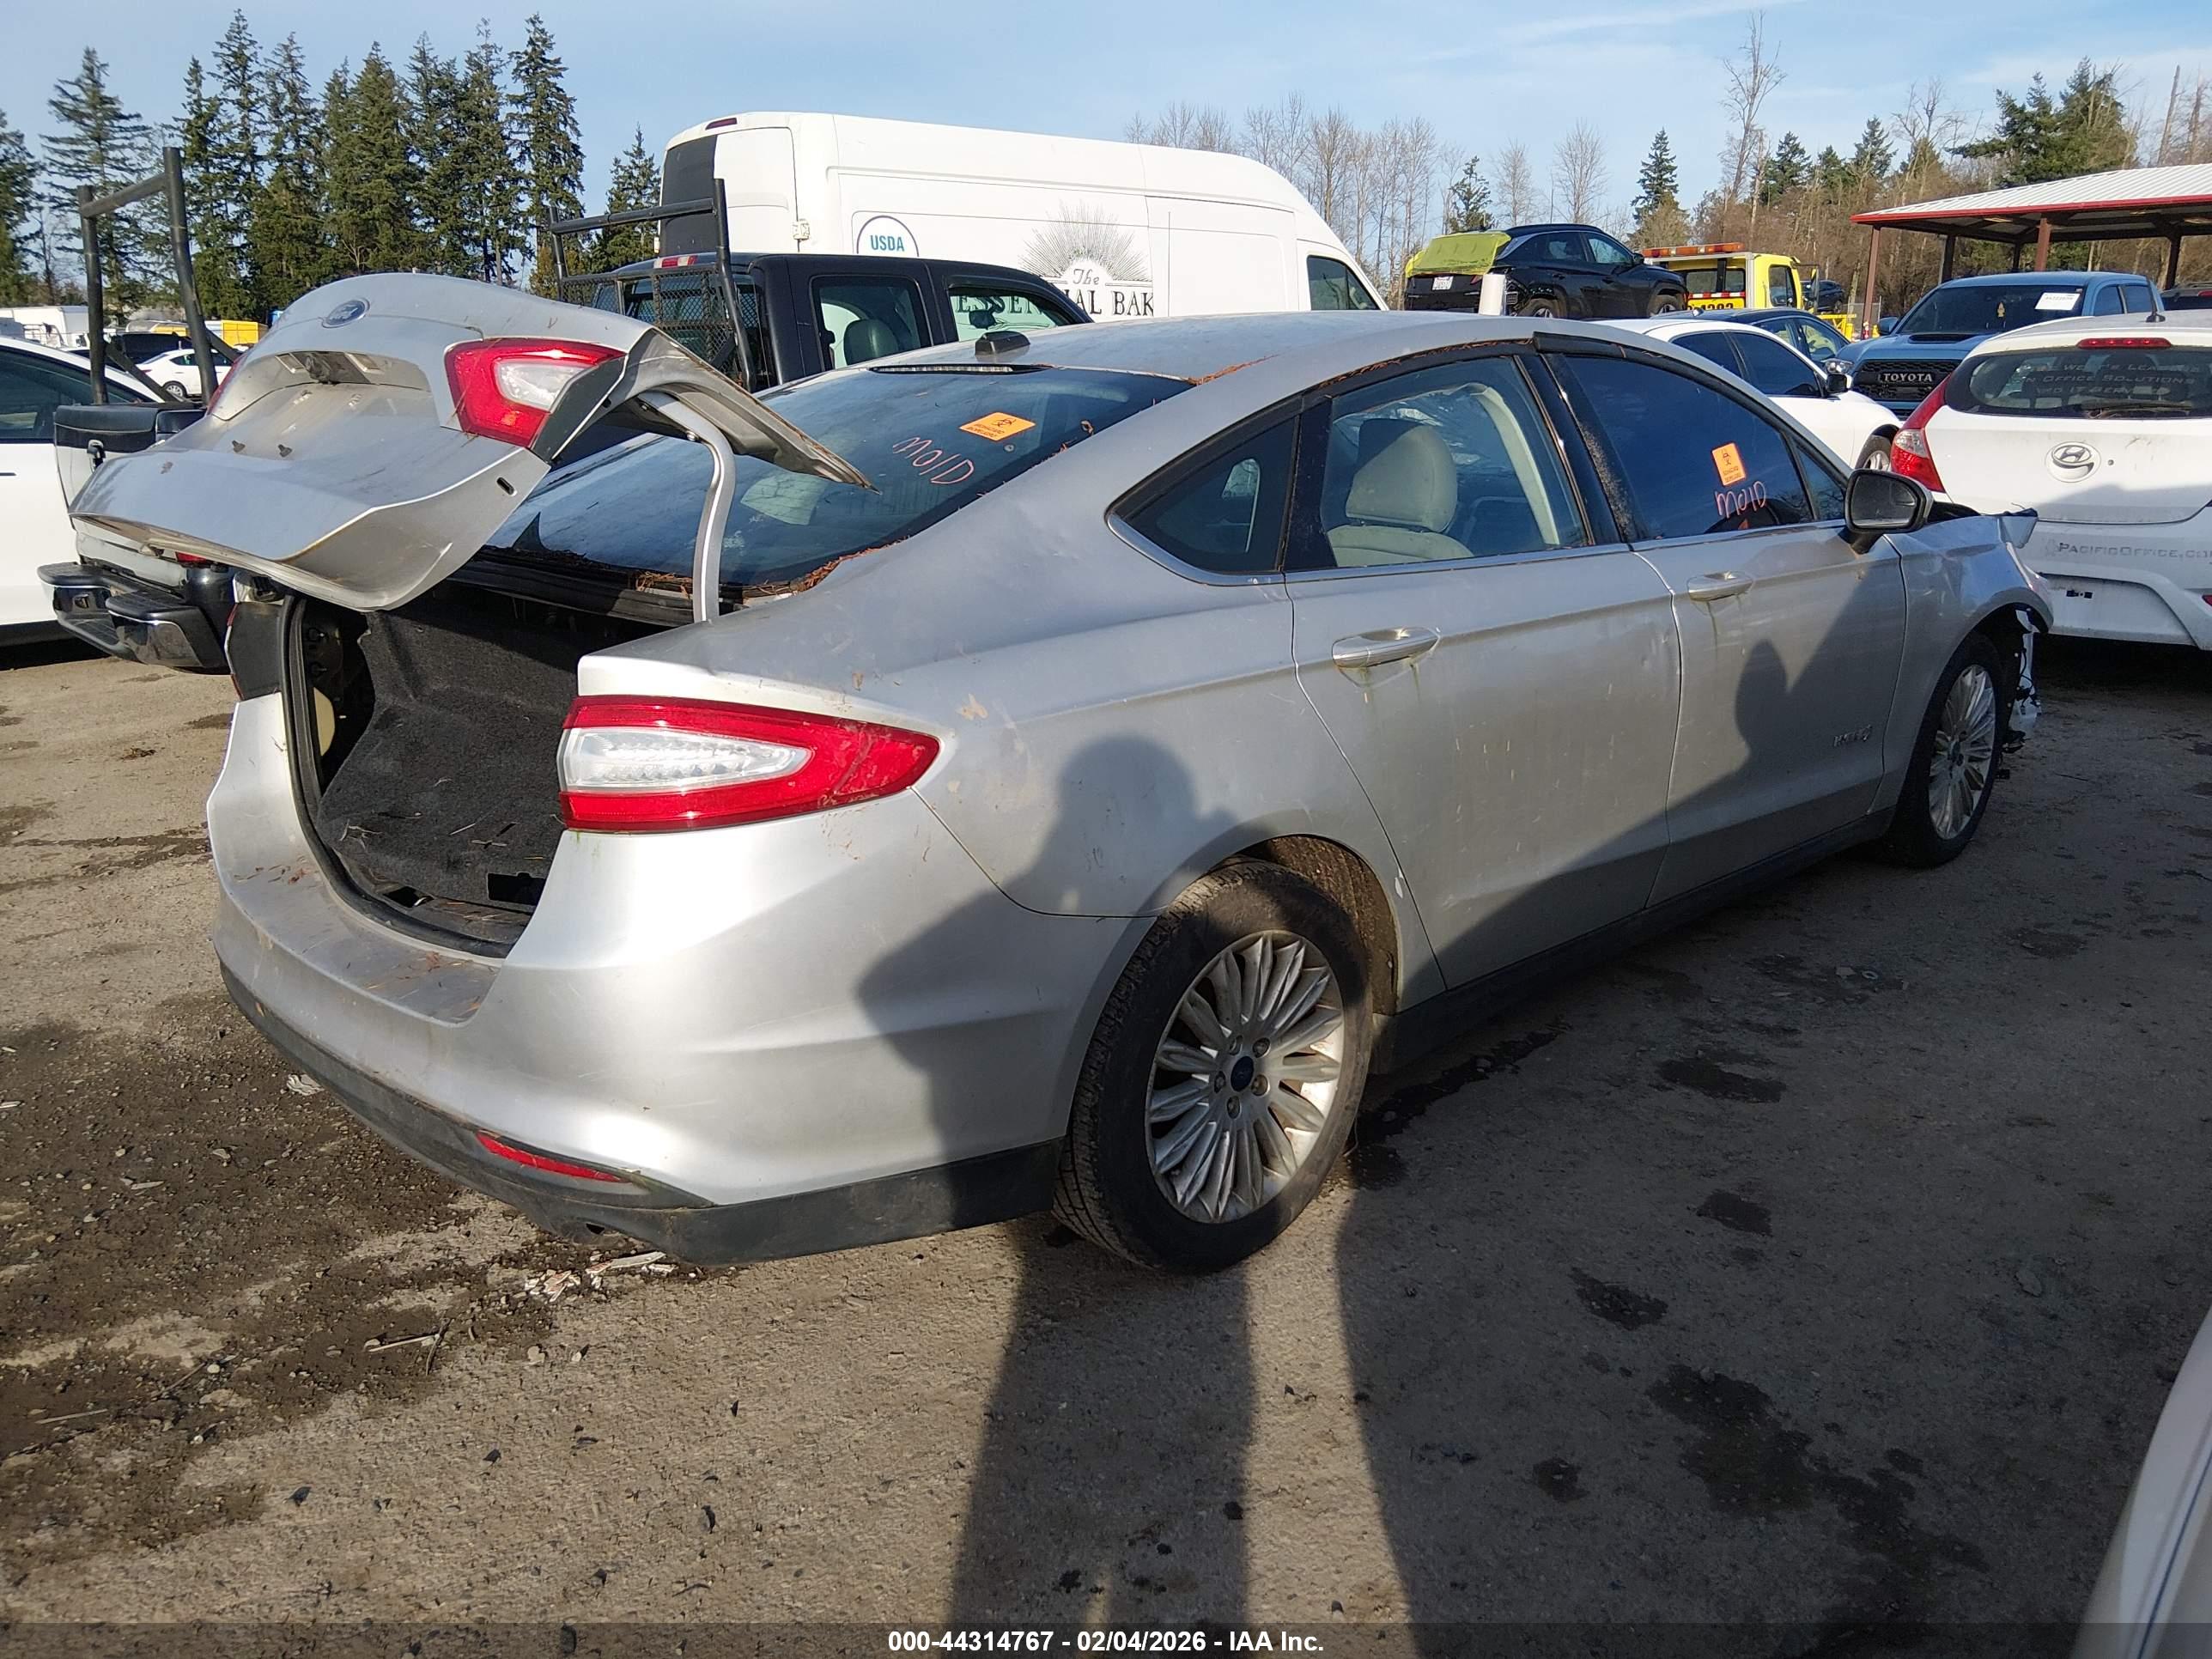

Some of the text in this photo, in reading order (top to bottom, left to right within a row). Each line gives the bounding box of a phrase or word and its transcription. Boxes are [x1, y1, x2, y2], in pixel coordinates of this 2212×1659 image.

[870, 234, 905, 252] USDA
[1073, 268, 1100, 286] The
[1883, 372, 1933, 382] TOYOTA
